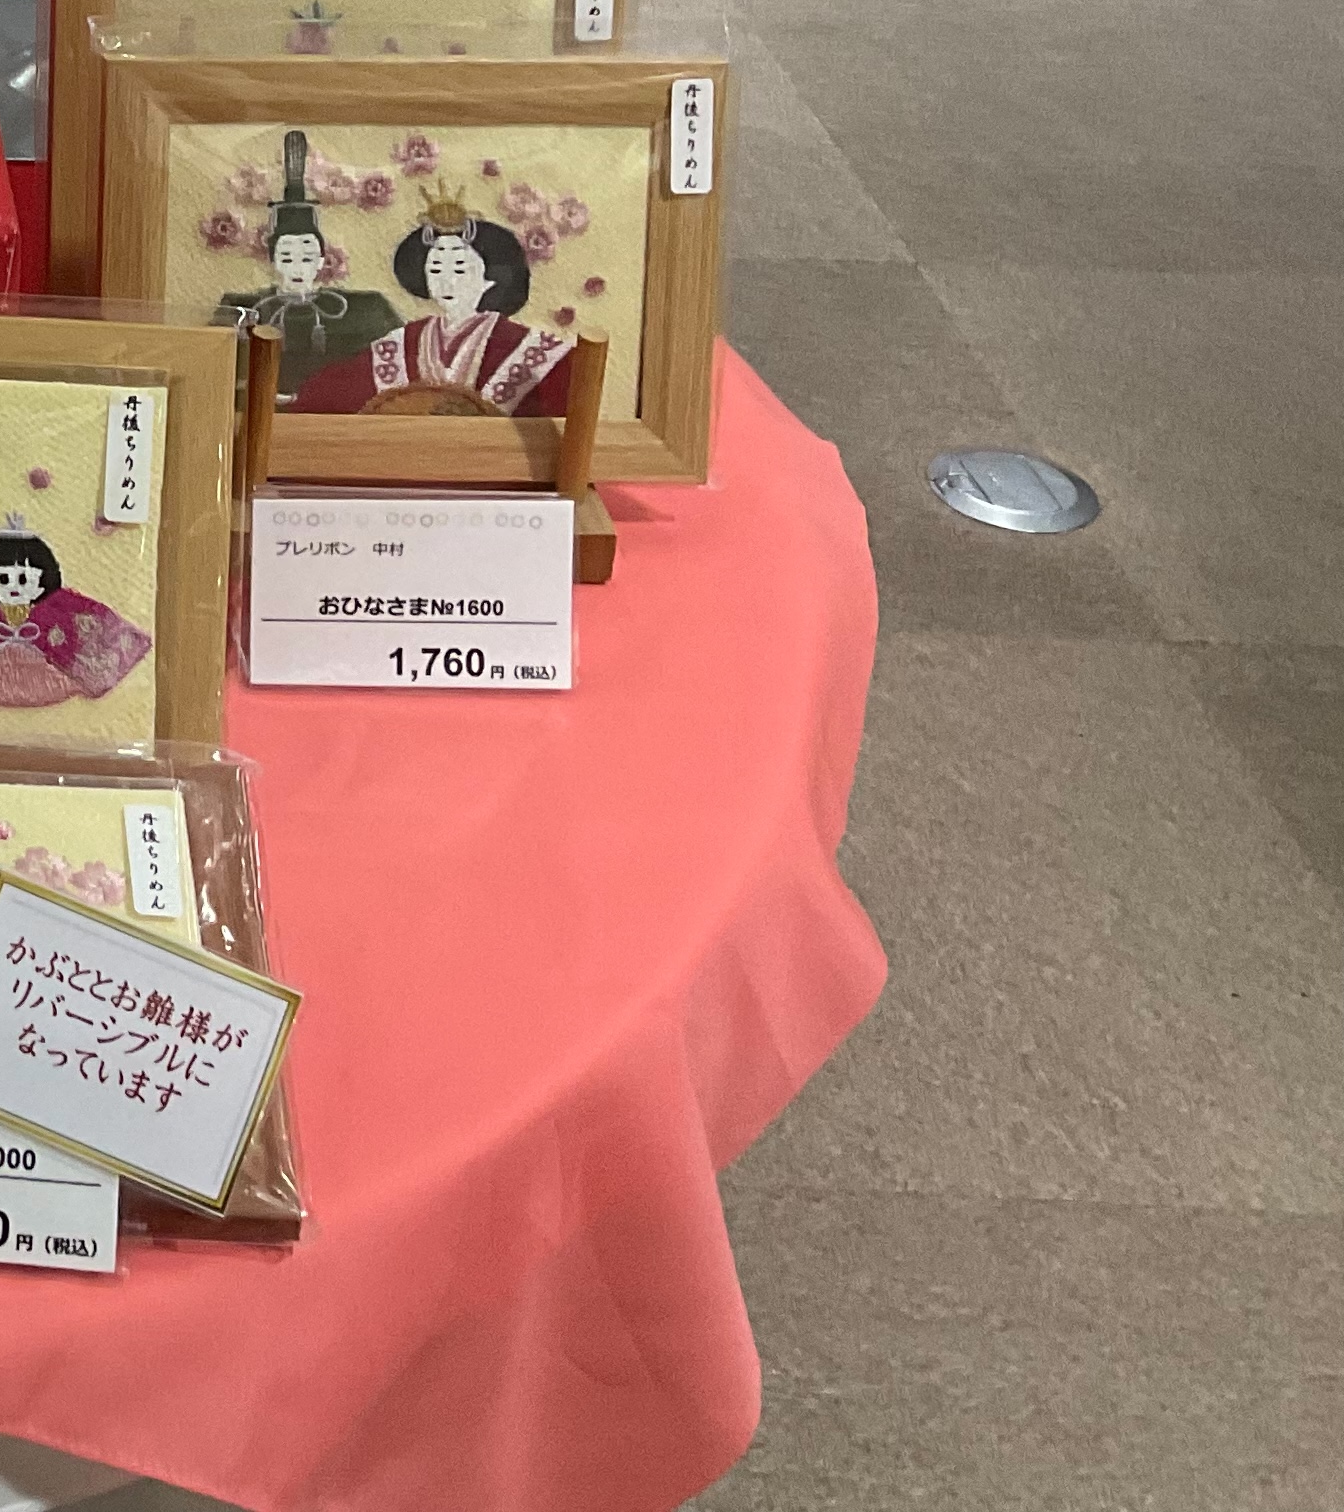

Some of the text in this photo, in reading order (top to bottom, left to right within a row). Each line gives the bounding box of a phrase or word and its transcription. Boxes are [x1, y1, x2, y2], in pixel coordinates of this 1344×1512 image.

[684, 83, 701, 189] 丹後ちりめん
[121, 395, 143, 510] 丹後ちりめん
[372, 541, 405, 557] 中村
[388, 647, 486, 682] 1,760
[138, 811, 166, 911] 丹後ちりめん
[6, 936, 249, 1053] かぶととお雛様が
[11, 979, 217, 1088] リバーシブルに
[16, 1024, 183, 1113] なっています
